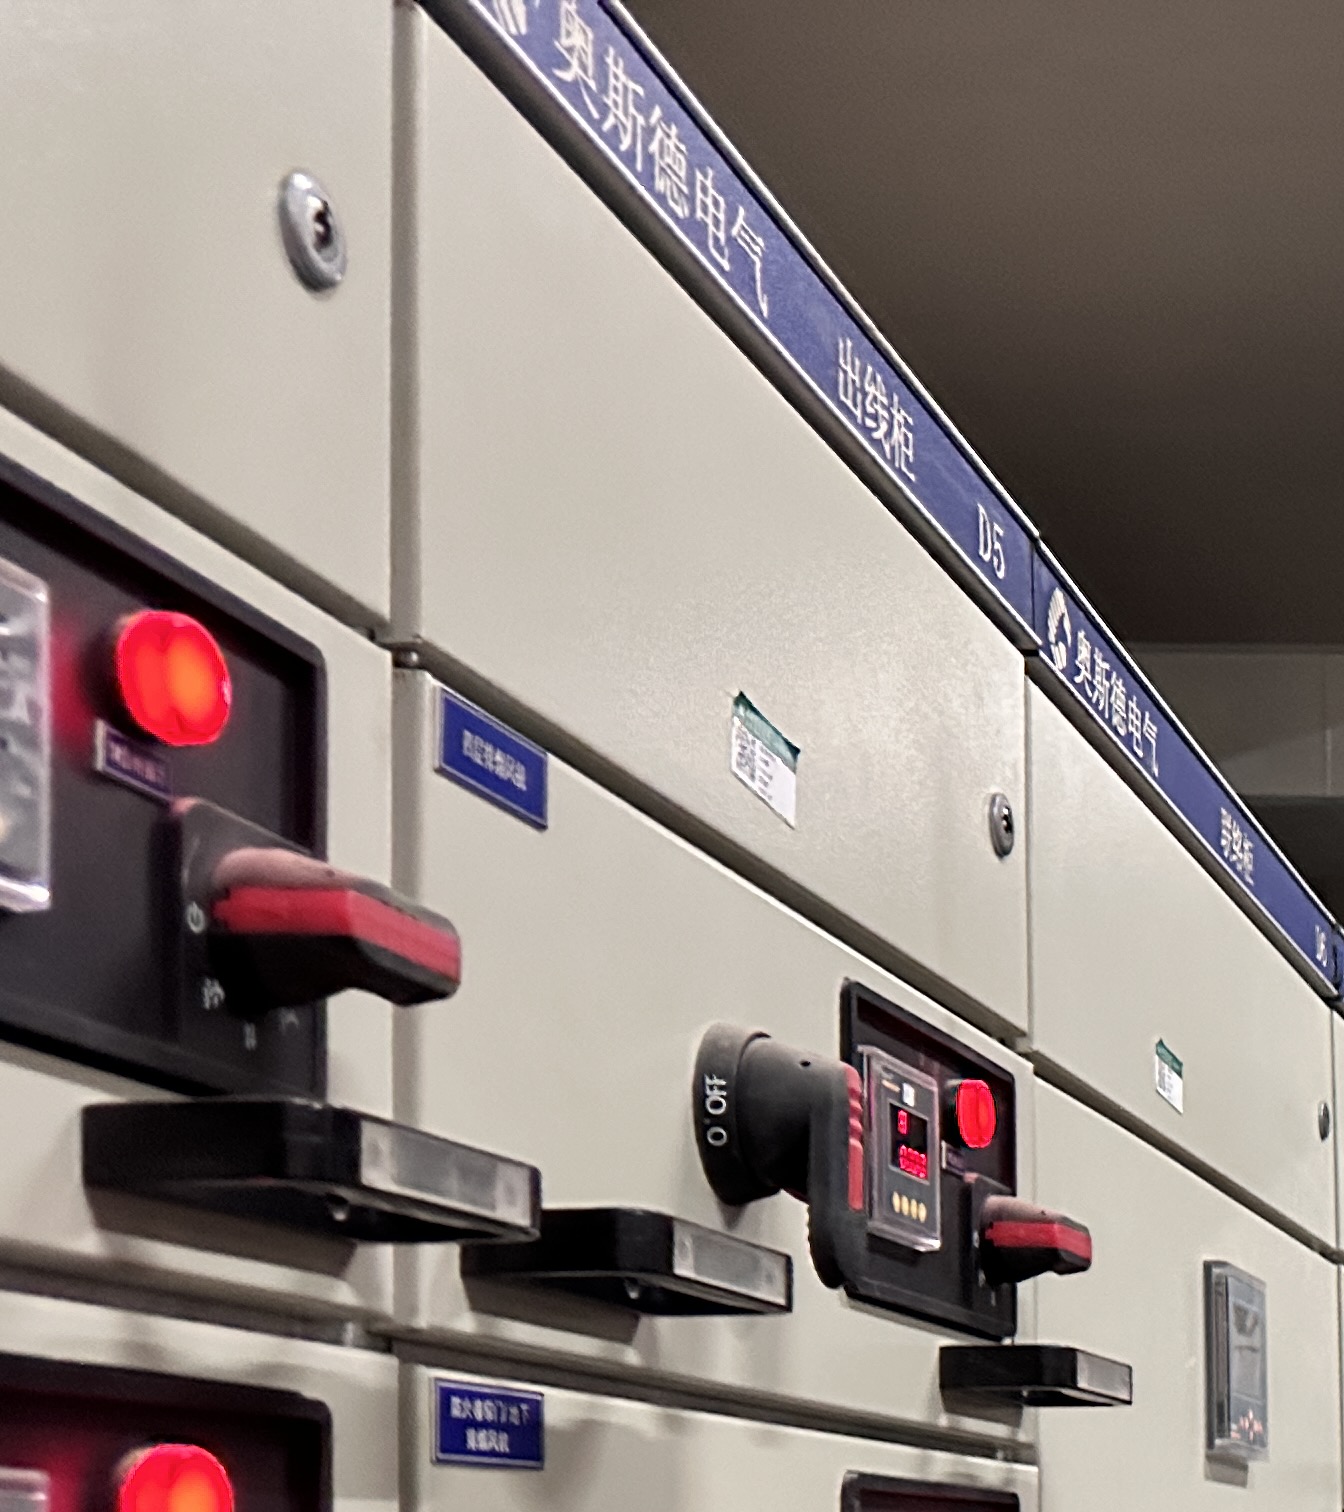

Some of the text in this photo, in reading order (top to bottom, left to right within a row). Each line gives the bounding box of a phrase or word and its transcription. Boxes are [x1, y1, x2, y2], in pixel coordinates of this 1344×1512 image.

[552, 0, 1005, 579] 奥斯德电气 出线柜 D5
[1074, 630, 1159, 777] 奥斯德电气
[704, 1073, 727, 1115] OFF
